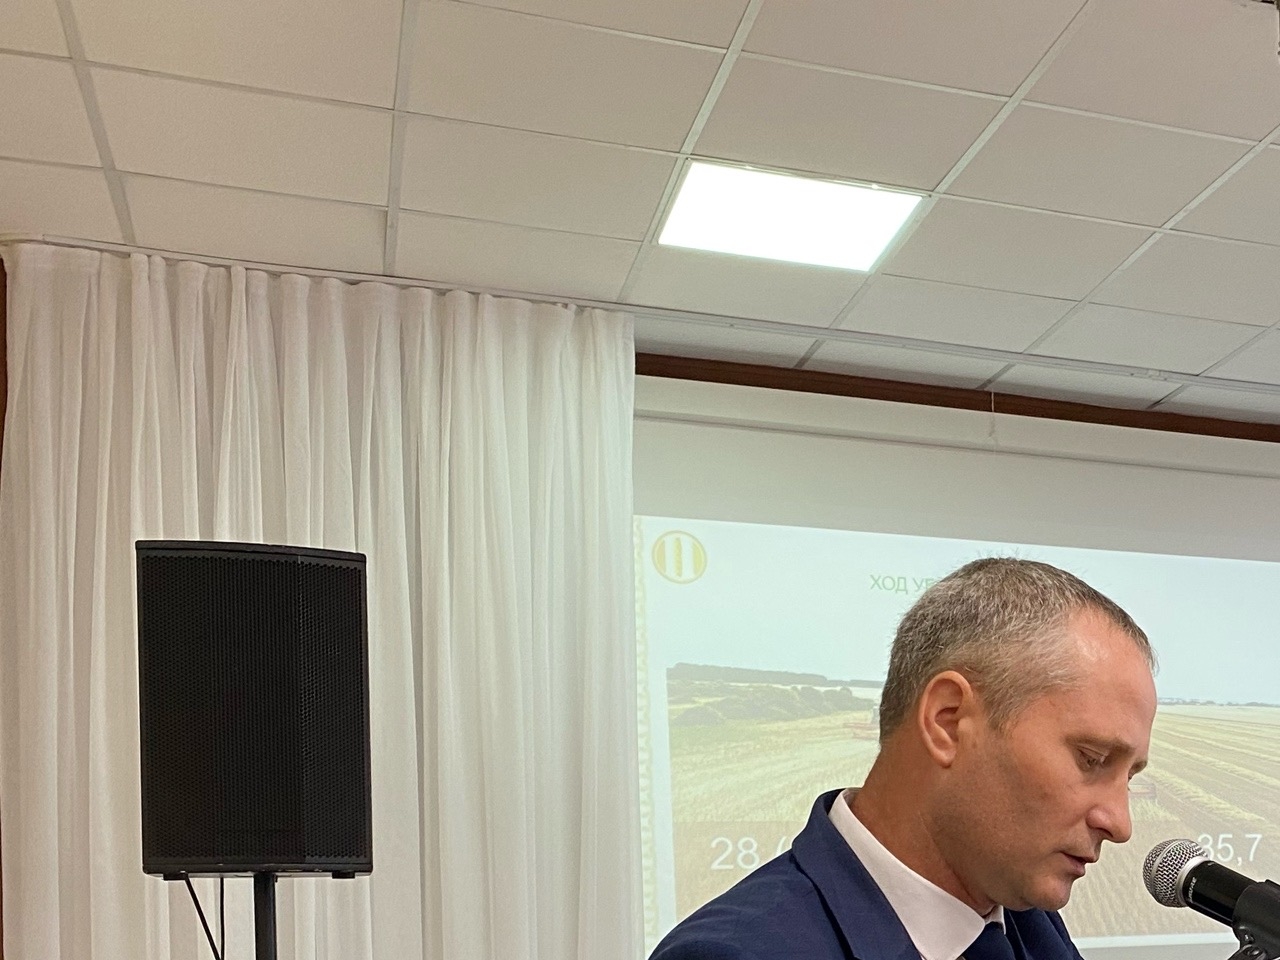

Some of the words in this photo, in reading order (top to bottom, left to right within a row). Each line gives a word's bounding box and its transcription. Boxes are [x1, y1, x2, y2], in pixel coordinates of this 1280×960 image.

[869, 574, 908, 594] ХОД
[710, 836, 760, 870] 28
[1197, 833, 1263, 866] 35,7
